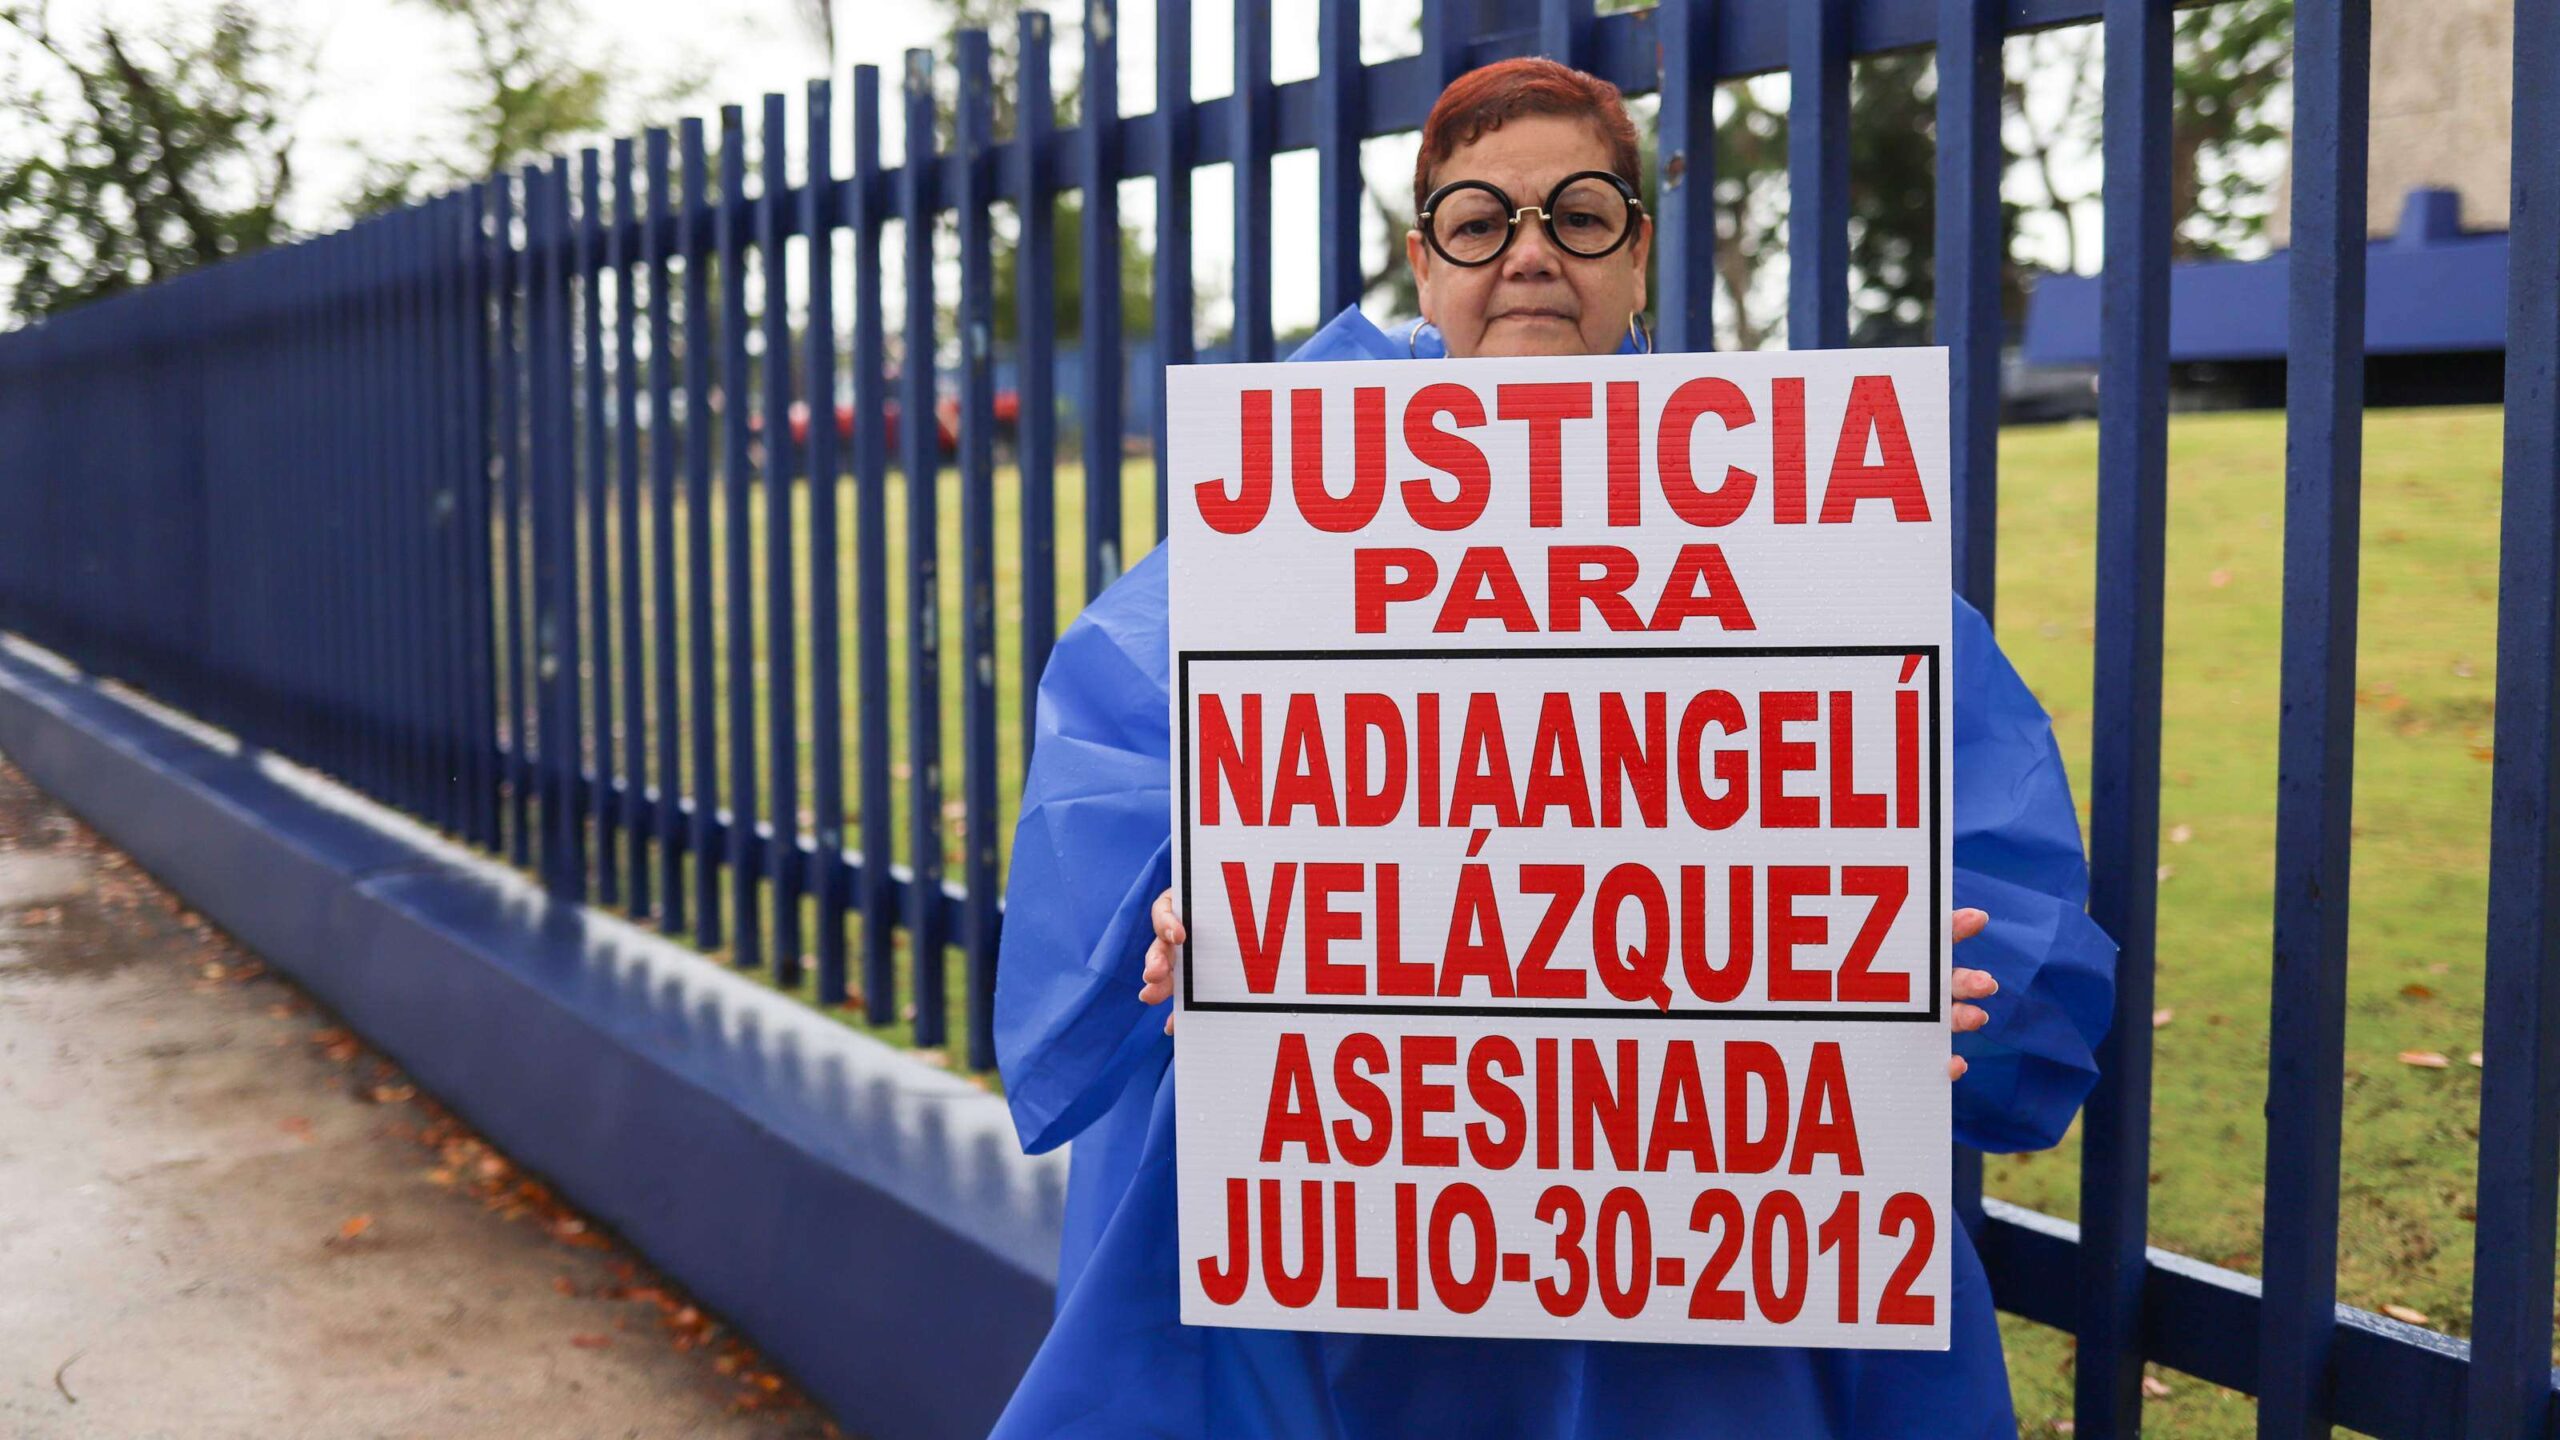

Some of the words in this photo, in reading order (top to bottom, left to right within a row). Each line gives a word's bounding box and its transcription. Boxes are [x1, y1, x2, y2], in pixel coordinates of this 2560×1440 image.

[1194, 375, 1932, 535] JUSTICIA
[1354, 543, 1757, 634] PARA
[1221, 828, 1911, 1014] VELÁZQUEZ
[1259, 1032, 1864, 1176] ASESINADA
[1197, 1177, 1936, 1326] JULIO-30-2012
